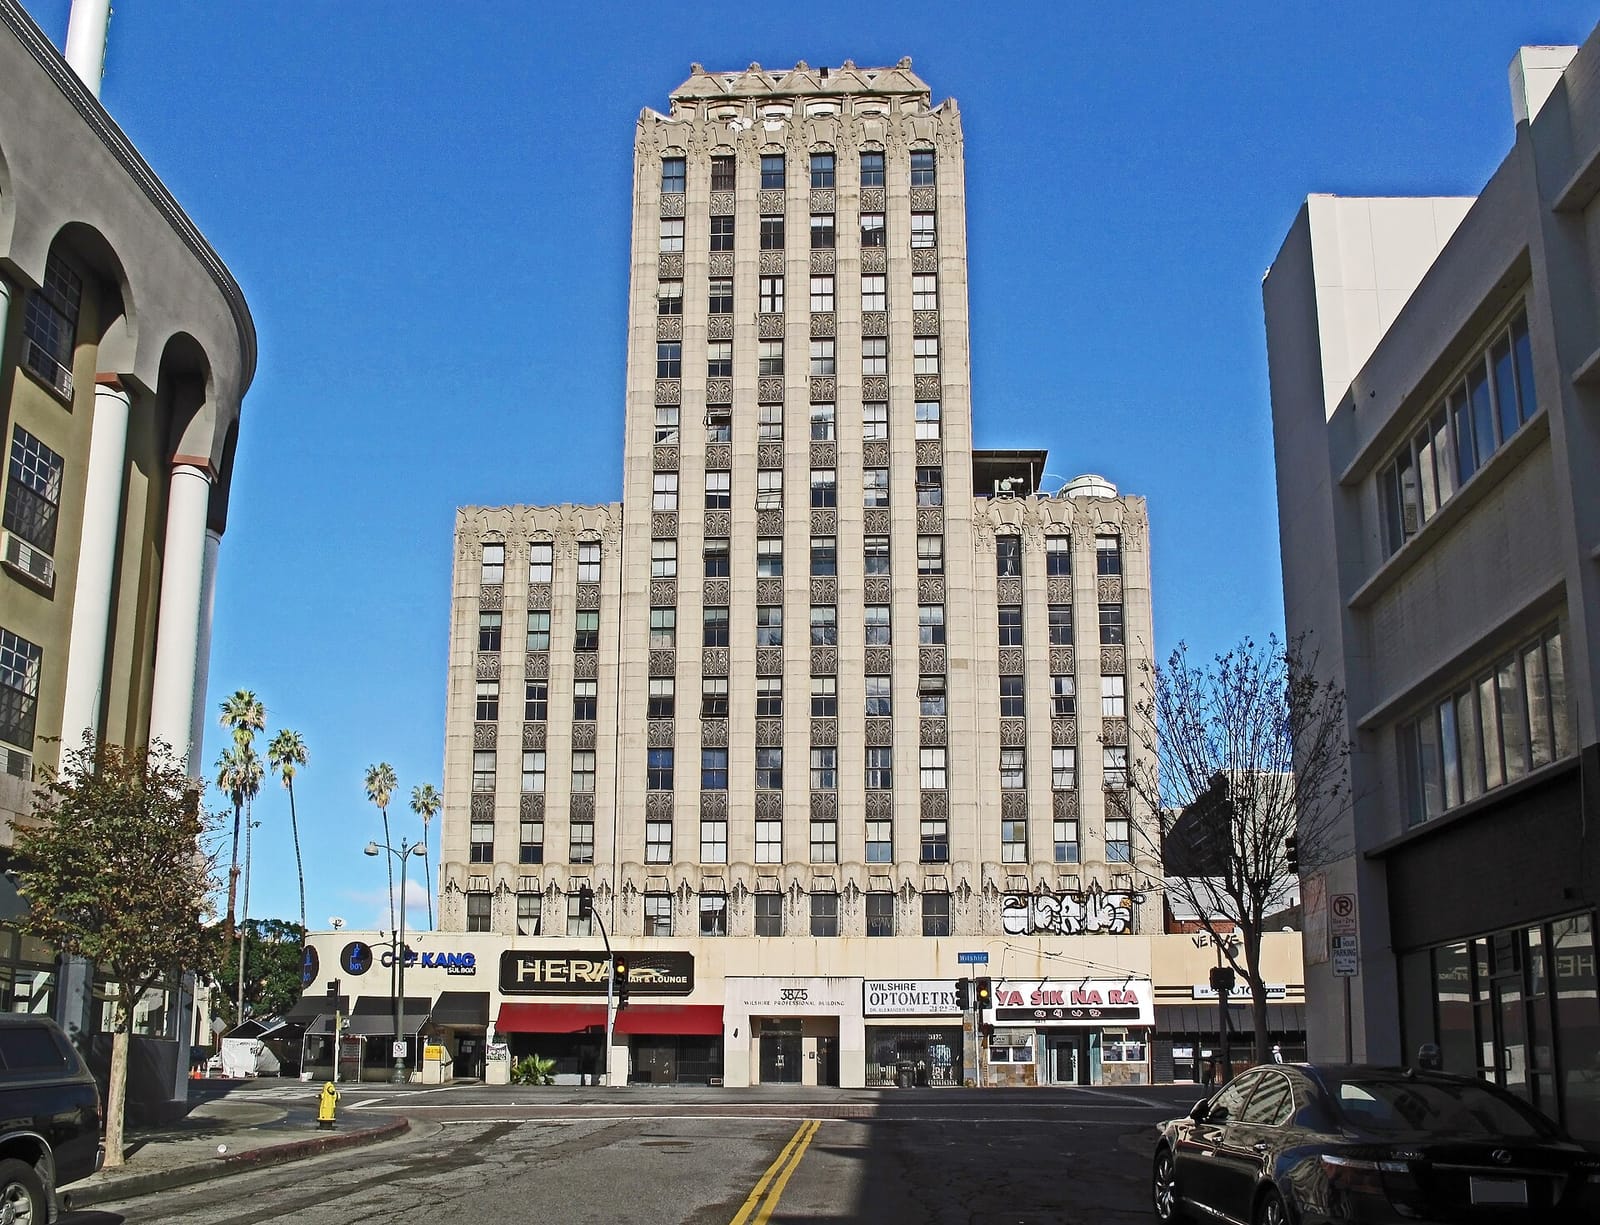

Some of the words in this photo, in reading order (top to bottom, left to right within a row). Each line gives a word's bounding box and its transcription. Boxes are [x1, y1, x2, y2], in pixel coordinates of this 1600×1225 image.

[421, 952, 475, 968] KANG
[780, 988, 808, 1000] 3875
[870, 983, 917, 991] WILSHIRE
[869, 992, 958, 1006] OPTOMETRY
[995, 990, 1024, 1006] YA
[1031, 990, 1064, 1006] SIK
[1071, 989, 1103, 1005] NA
[1108, 989, 1139, 1005] RA
